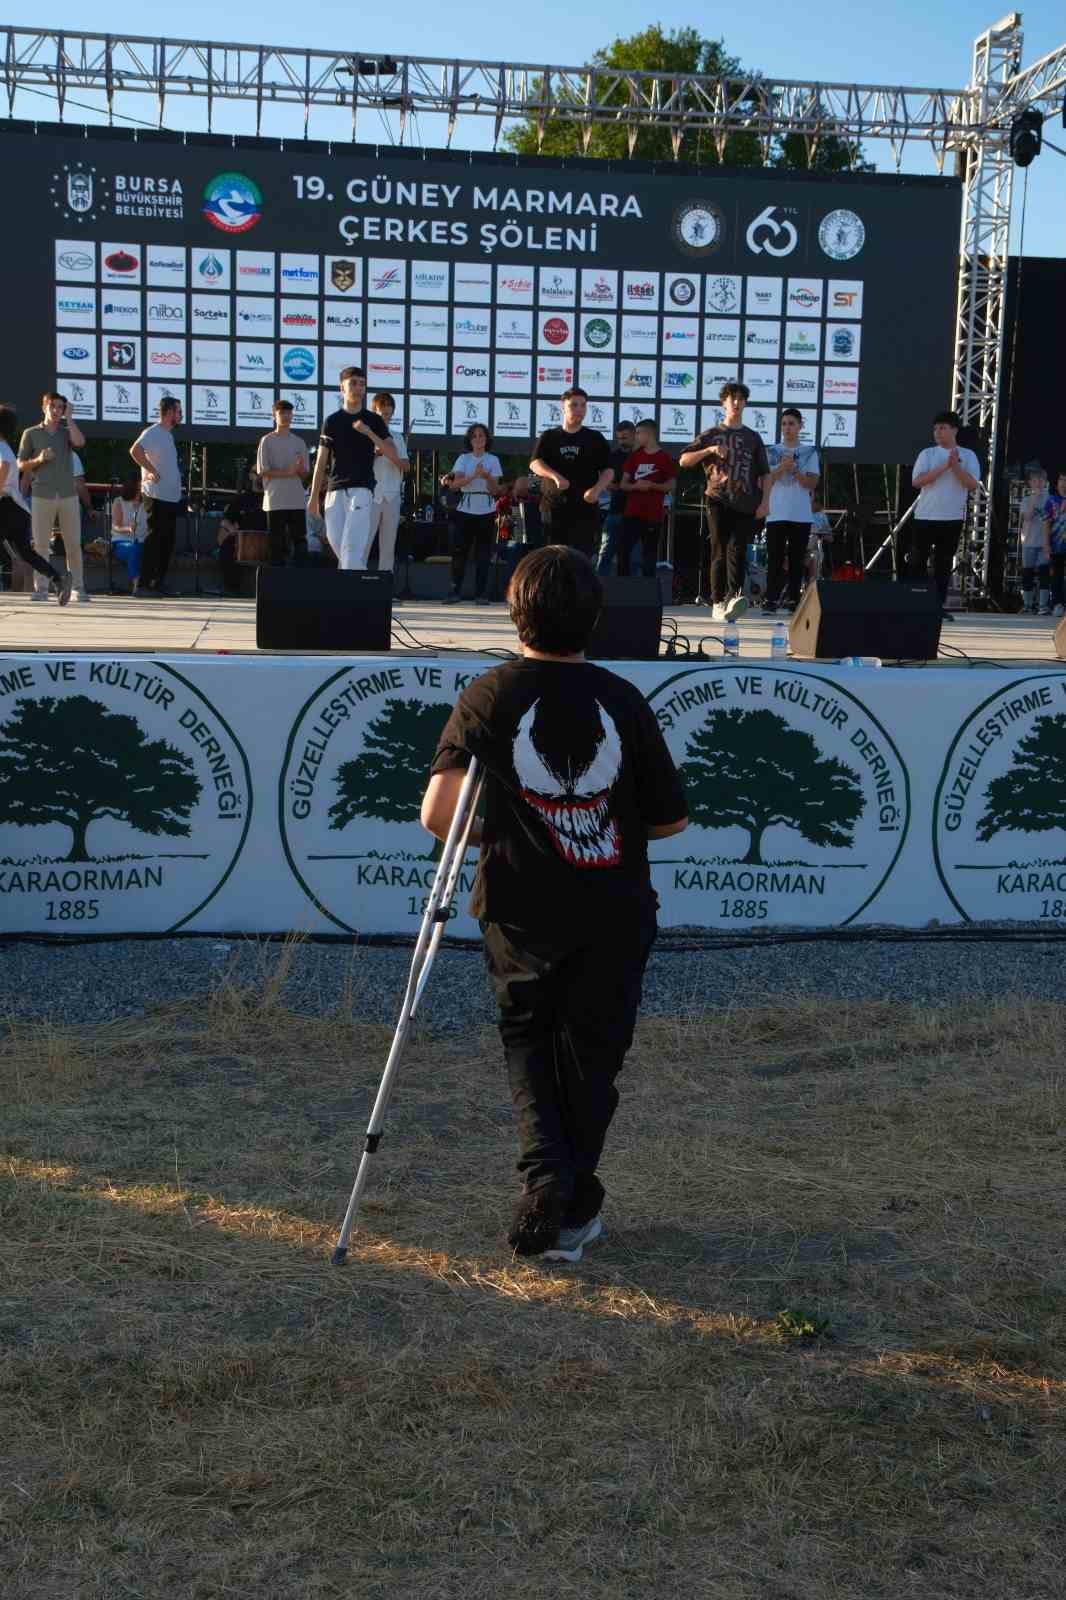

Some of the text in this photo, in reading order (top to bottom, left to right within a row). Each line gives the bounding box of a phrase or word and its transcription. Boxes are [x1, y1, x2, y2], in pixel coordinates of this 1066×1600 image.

[115, 175, 183, 194] BURSA
[292, 174, 643, 218] 19. GÜNEY MARMARA
[115, 204, 183, 219] BELEDİYESİ
[338, 215, 598, 253] ÇERKES ŞÖLENİ
[45, 661, 77, 681] VE
[89, 662, 176, 711] KÜLTÜR
[178, 709, 242, 820] DERNEĞİ
[290, 666, 443, 819] GÜZELLEŞTİRME VE
[734, 676, 763, 695] VE
[773, 679, 849, 730] KÜLTÜR
[850, 728, 902, 832] DERNEĞİ
[944, 686, 1053, 832] GÜZELLEŞTİRME
[674, 869, 826, 895] KARAORMAN
[45, 899, 100, 921] 1885
[719, 899, 768, 919] 1885
